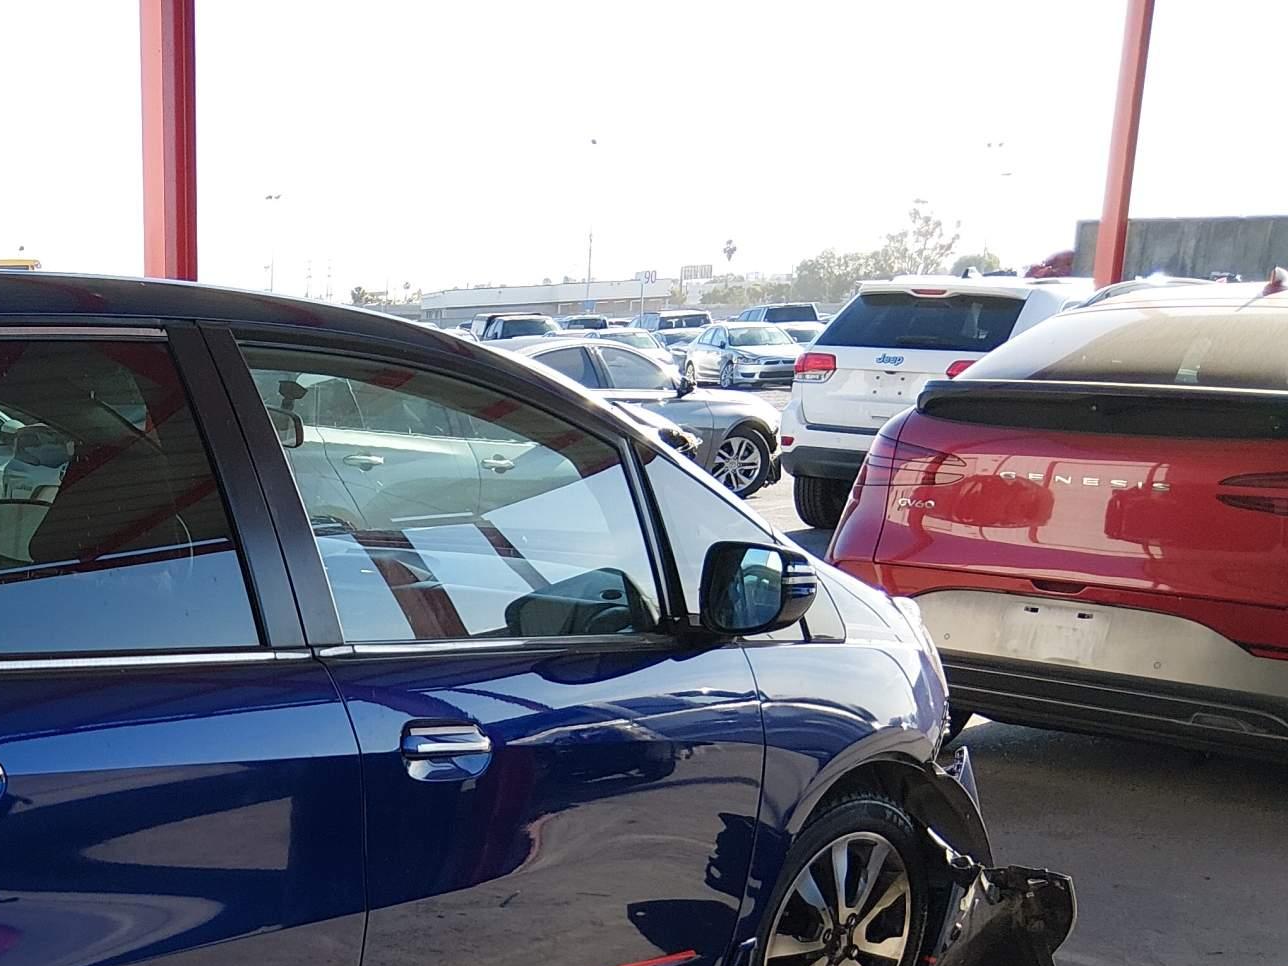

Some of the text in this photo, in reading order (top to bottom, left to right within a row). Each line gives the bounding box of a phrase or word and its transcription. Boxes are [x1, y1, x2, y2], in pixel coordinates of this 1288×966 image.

[644, 270, 657, 284] 90
[875, 353, 905, 366] Jeep
[999, 471, 1171, 491] GENESIS
[898, 498, 935, 509] GV60
